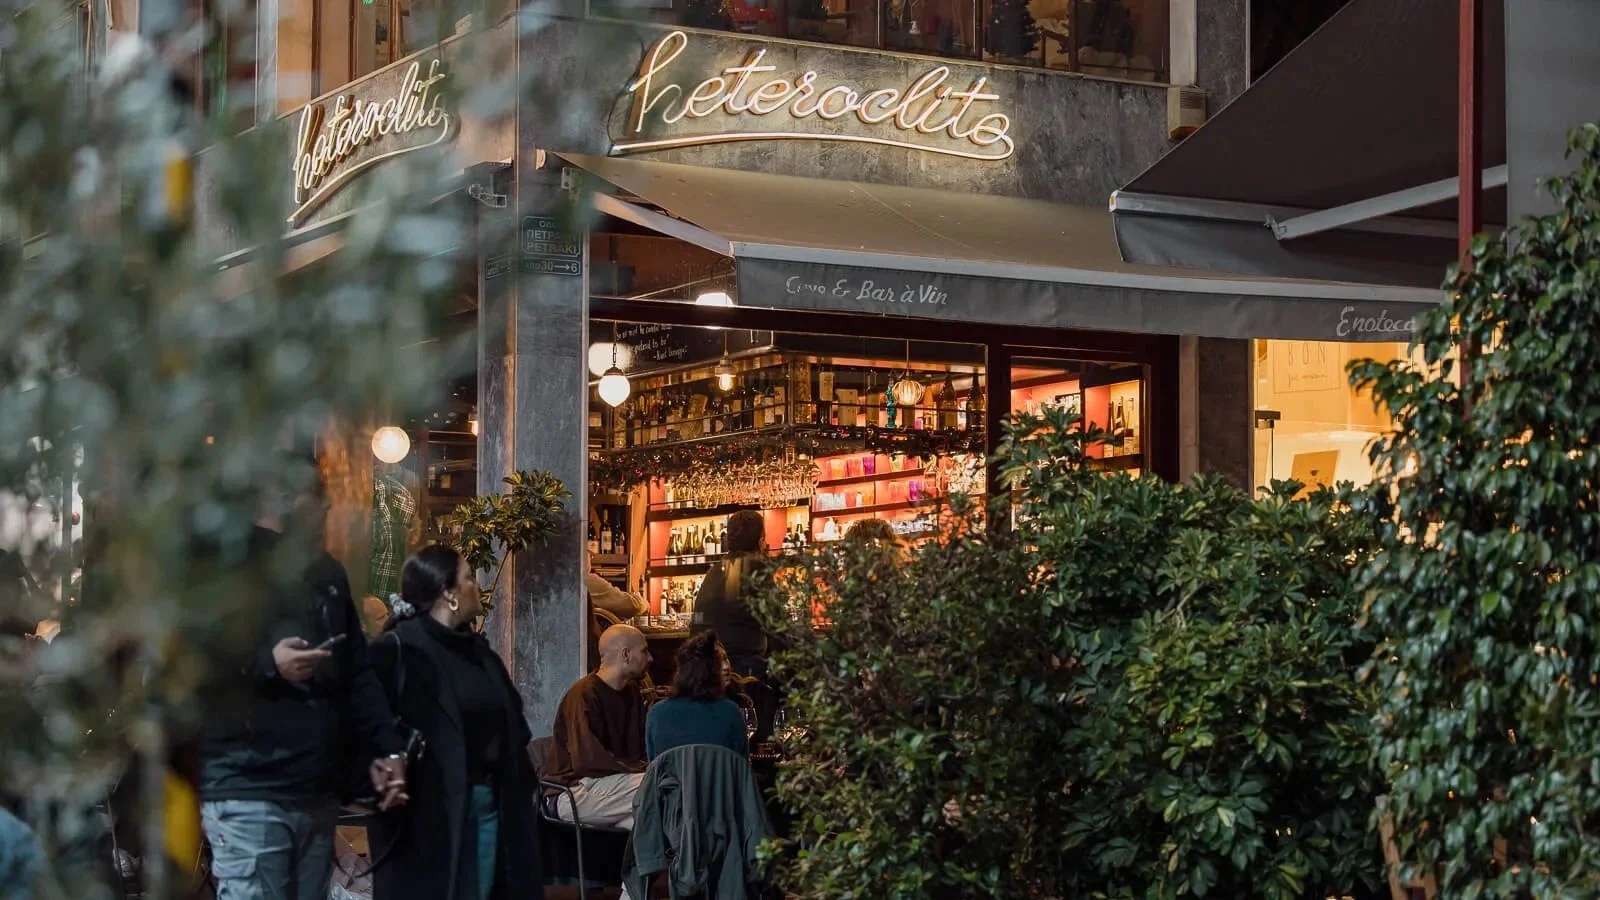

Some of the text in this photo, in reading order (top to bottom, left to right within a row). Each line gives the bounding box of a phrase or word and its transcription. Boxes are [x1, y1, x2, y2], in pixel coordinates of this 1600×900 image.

[626, 30, 1015, 160] heteroclito
[832, 279, 851, 297] &
[856, 280, 896, 302] Bar
[900, 284, 914, 303] à
[919, 284, 949, 305] Vin
